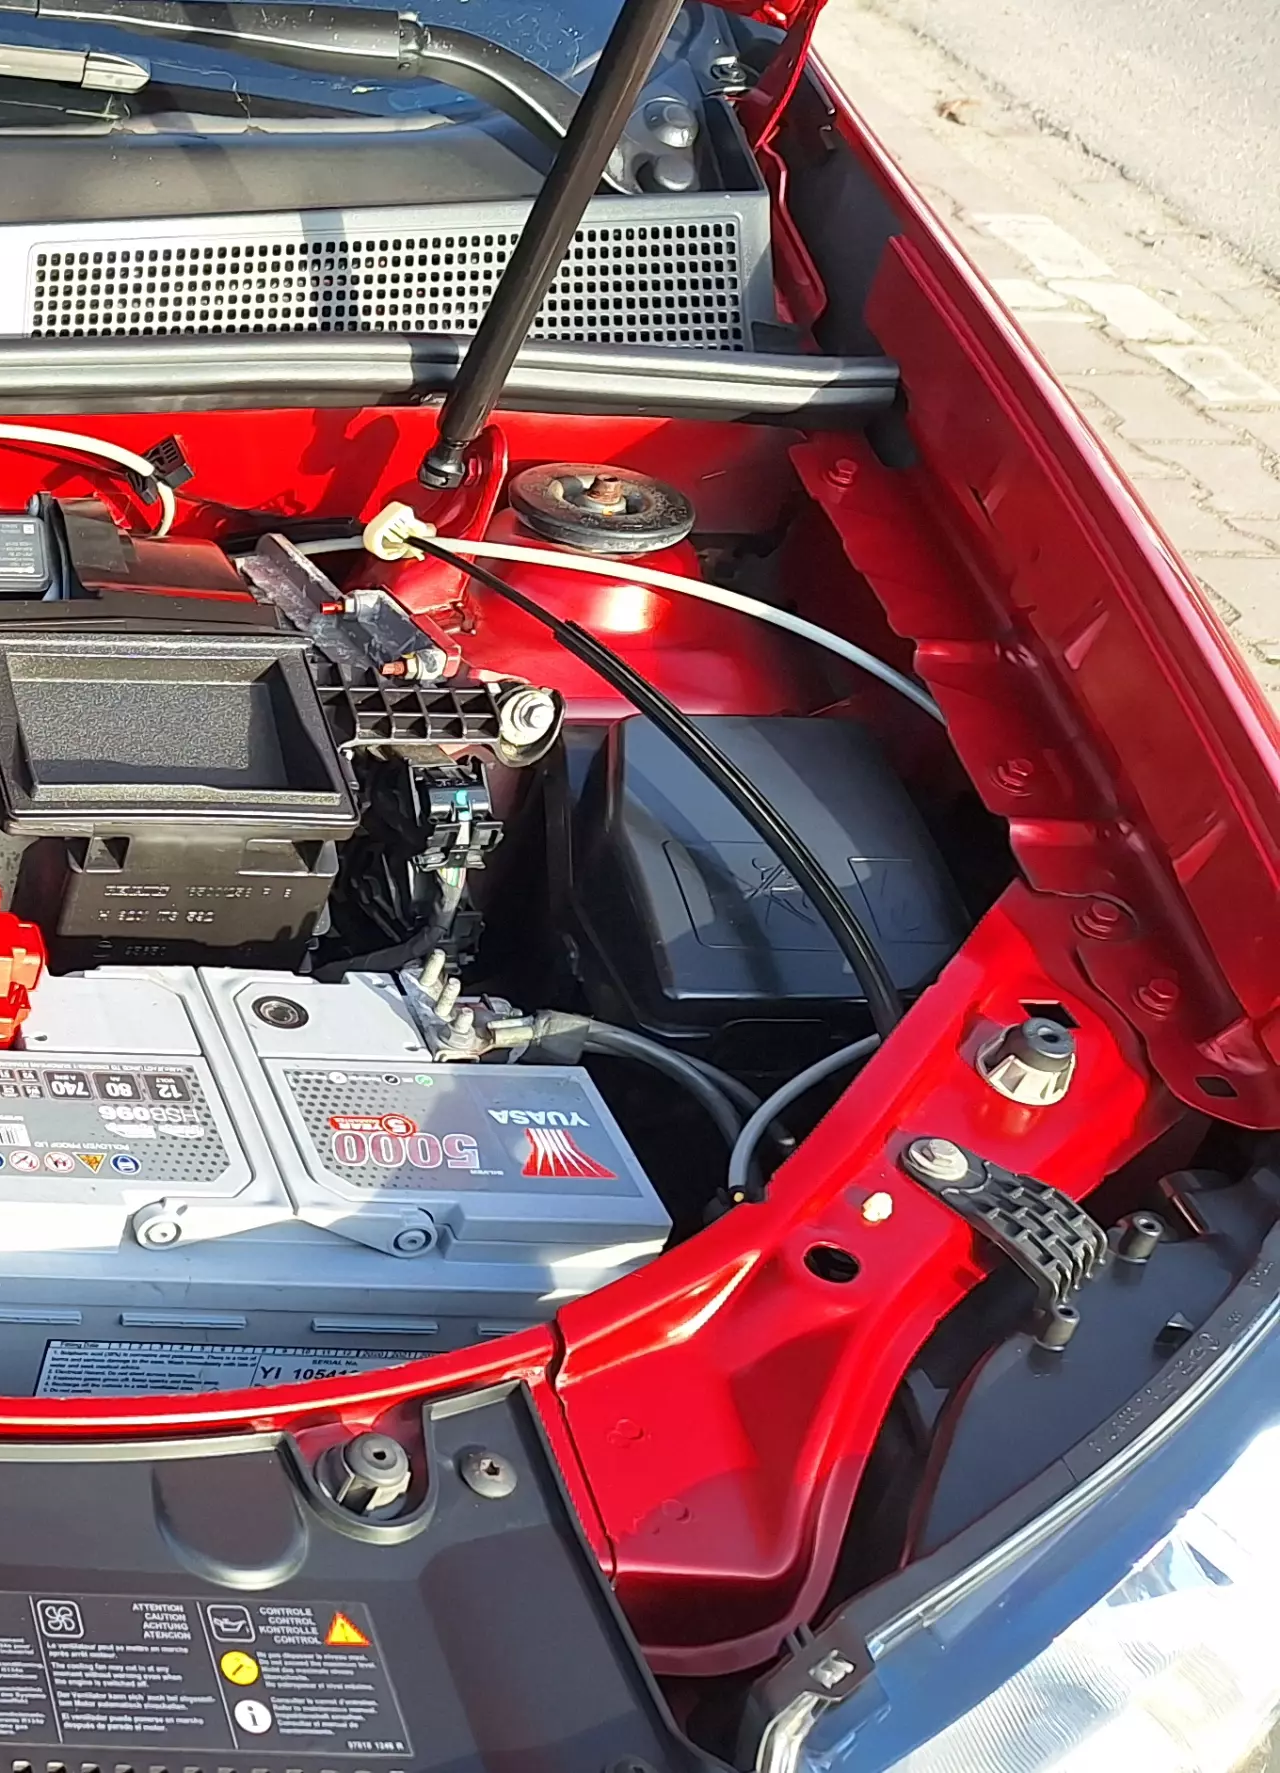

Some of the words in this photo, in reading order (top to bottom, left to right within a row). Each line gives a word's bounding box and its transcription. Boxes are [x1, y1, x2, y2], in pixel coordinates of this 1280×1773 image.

[51, 1080, 89, 1097] 740
[105, 1081, 132, 1097] 80
[157, 1083, 183, 1098] 12
[98, 1105, 199, 1123] HSB096
[488, 1108, 590, 1128] YUASA
[336, 1121, 381, 1130] YEAR
[387, 1118, 405, 1132] 5
[331, 1132, 480, 1169] 5000
[261, 1367, 282, 1379] YI
[132, 1603, 184, 1612] ATTENTION
[259, 1607, 313, 1616] CONTROLE
[145, 1613, 186, 1621] CAUTION
[268, 1617, 316, 1625] CONTROL
[143, 1622, 188, 1630] ACHTUNG
[258, 1626, 319, 1635] KONTROLLE
[144, 1631, 191, 1640] ATENCION
[274, 1636, 321, 1645] CONTROL
